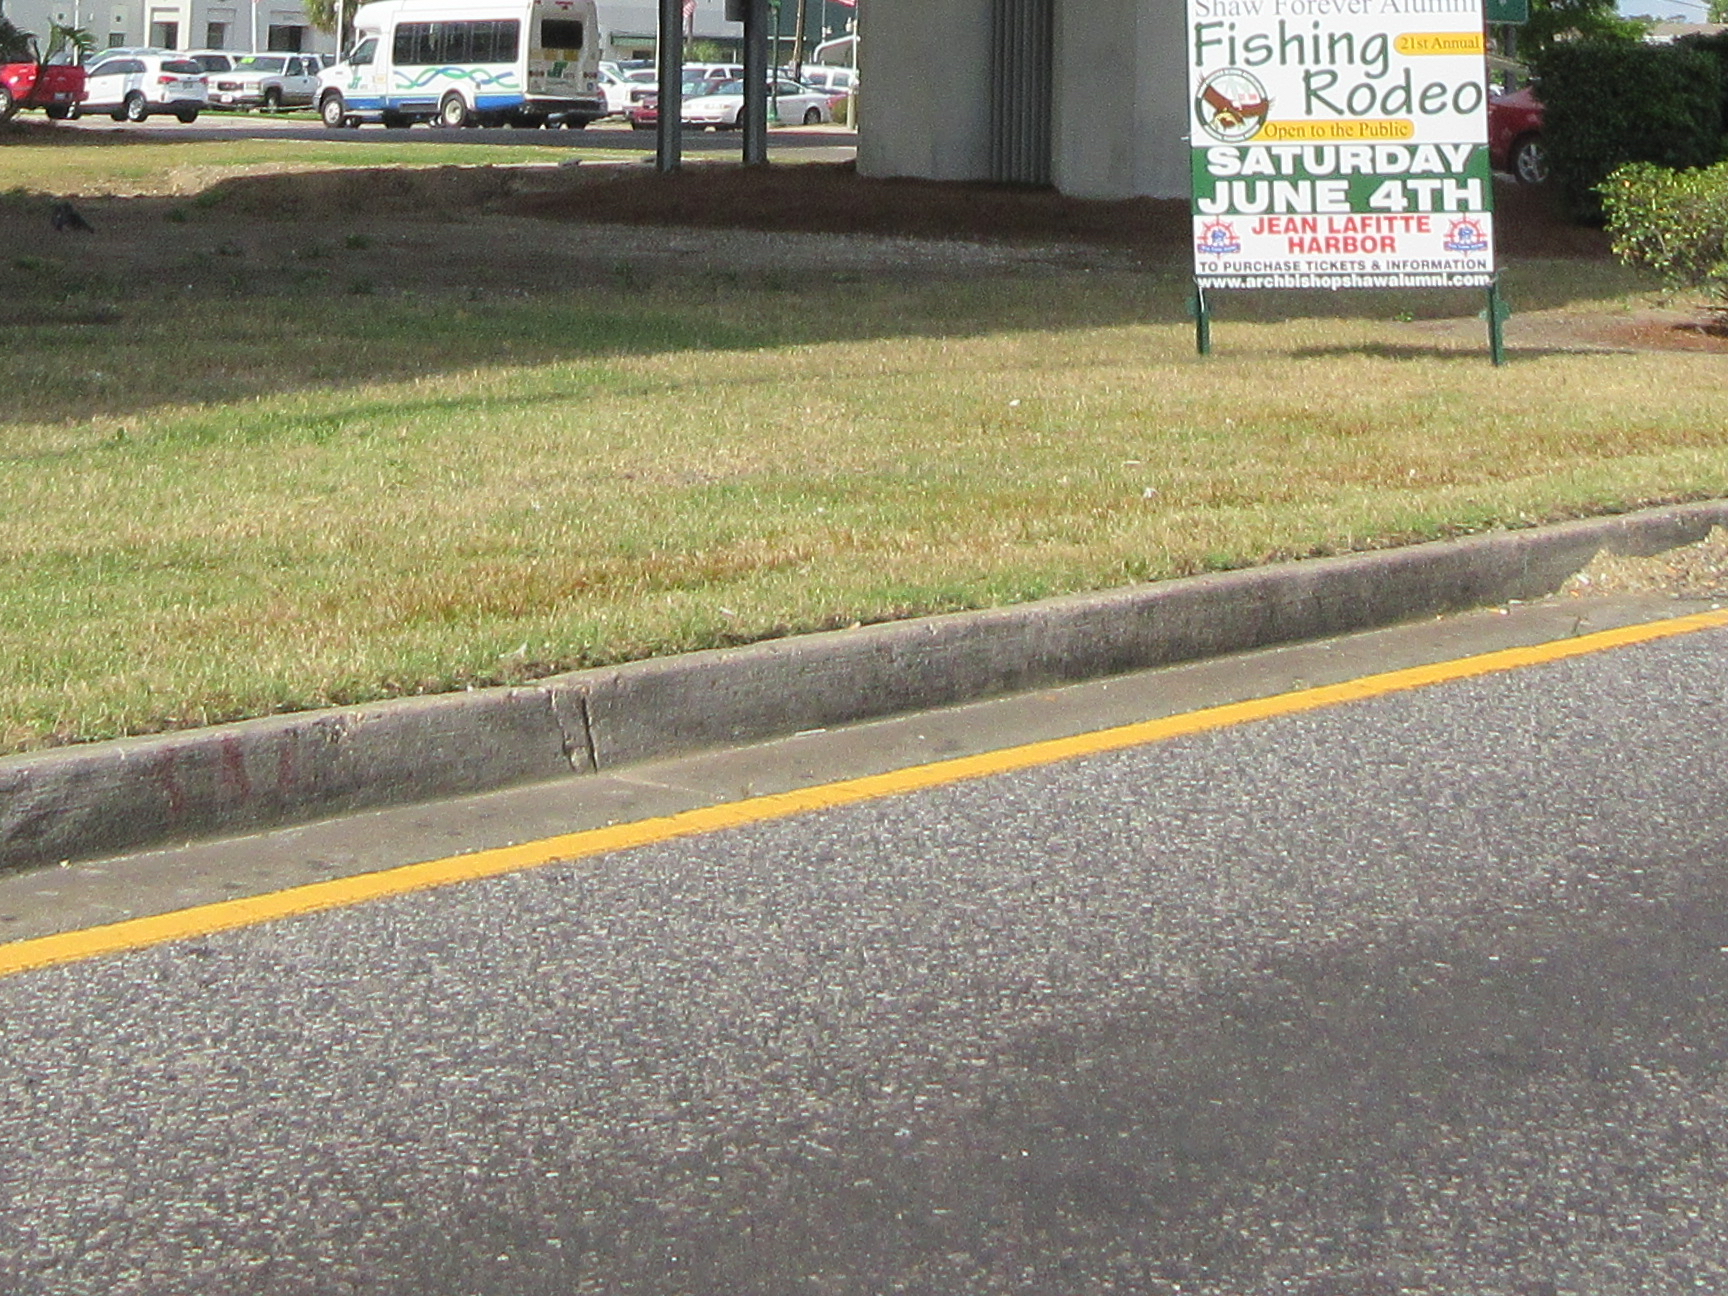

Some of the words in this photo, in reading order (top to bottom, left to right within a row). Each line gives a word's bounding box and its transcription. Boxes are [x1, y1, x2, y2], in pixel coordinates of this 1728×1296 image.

[1194, 18, 1389, 79] Fishing
[1400, 37, 1428, 50] 21st
[1431, 35, 1481, 49] Annual
[1302, 67, 1483, 116] Rodeo
[1264, 123, 1306, 140] Open
[1311, 123, 1326, 138] to
[1331, 122, 1354, 138] the
[1359, 121, 1409, 137] Public
[1206, 144, 1473, 177] SATURDAY
[1197, 179, 1351, 215] JUNE
[1369, 178, 1482, 212] 4TH
[1251, 216, 1318, 235] JEAN
[1327, 215, 1432, 235] LAFITTE
[1288, 236, 1397, 255] HARBOR
[1199, 261, 1218, 272] TO
[1223, 260, 1301, 272] PURCHASE
[1306, 260, 1366, 271] TICKETS
[1371, 260, 1382, 271] &
[1386, 259, 1487, 270] INFORMATION
[1197, 273, 1490, 291] www.archbishopshawalumni.com
